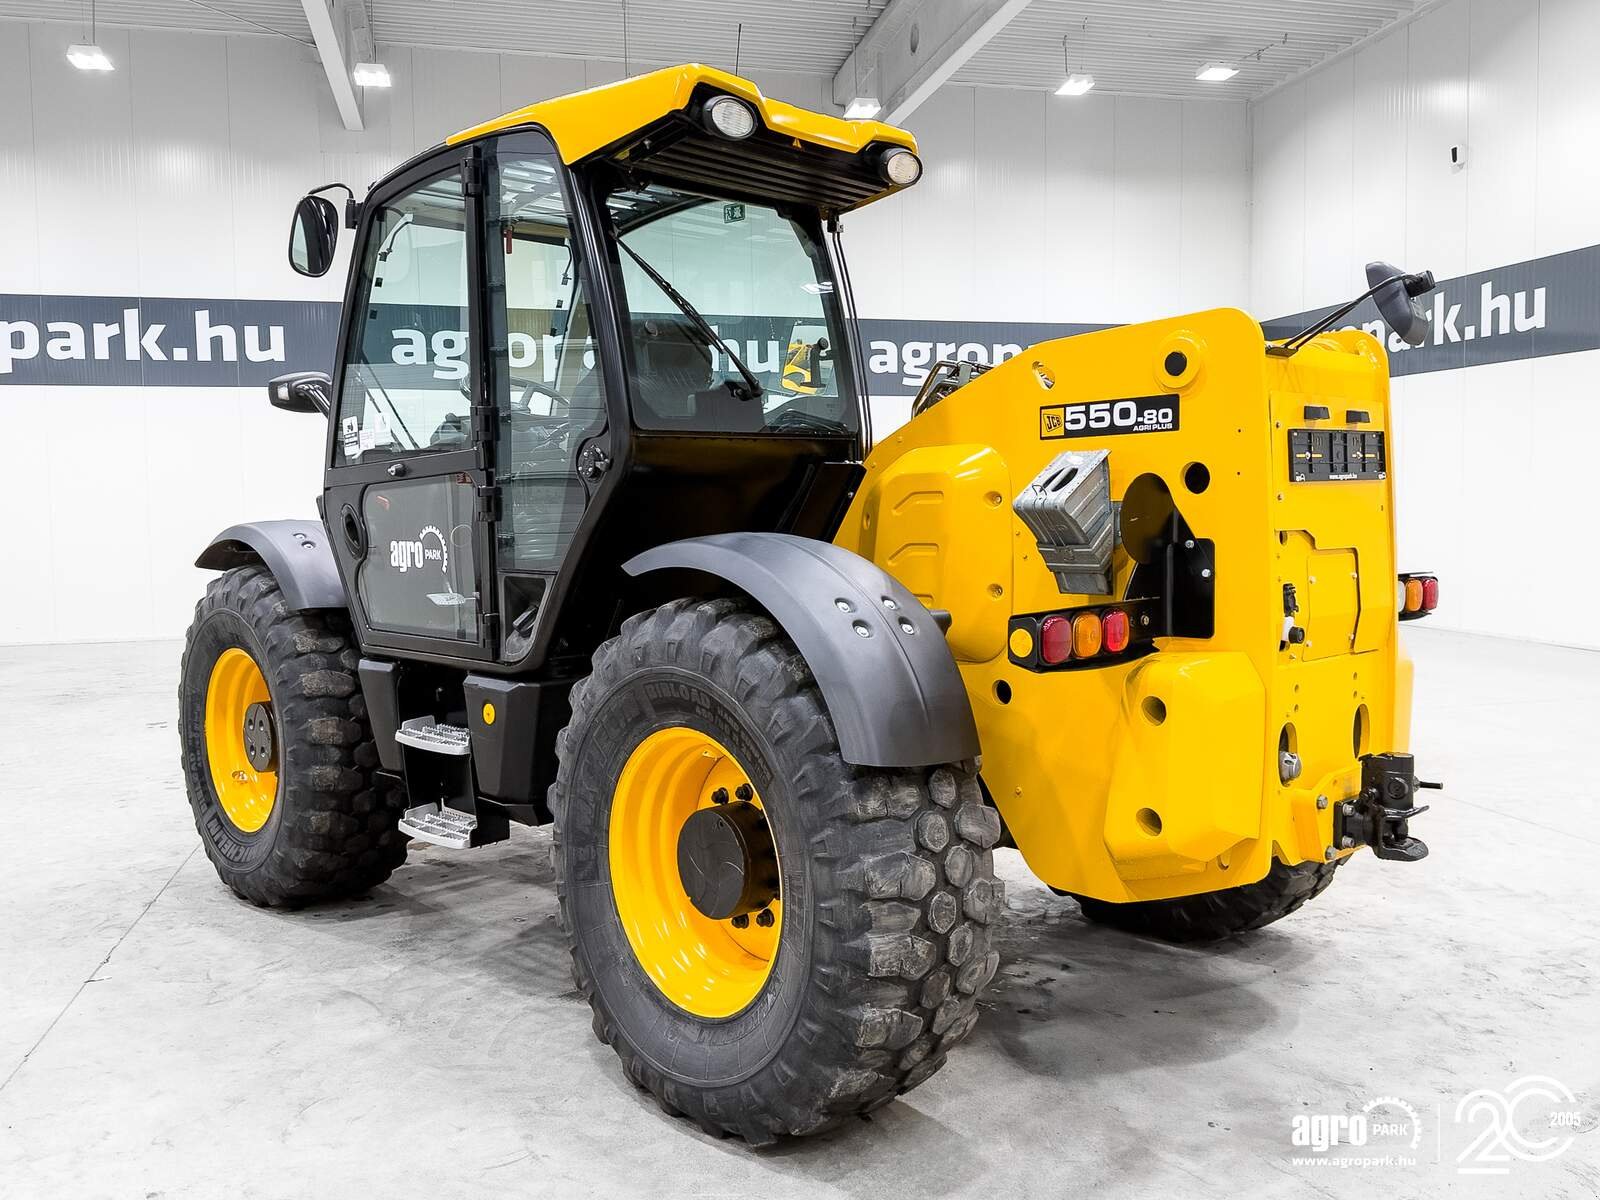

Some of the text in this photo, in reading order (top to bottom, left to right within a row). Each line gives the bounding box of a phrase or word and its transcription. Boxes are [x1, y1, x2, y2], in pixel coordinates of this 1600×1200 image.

[1044, 400, 1173, 431] JCB 550-80
[1132, 422, 1173, 432] AGRI PLUS
[390, 540, 442, 573] agro PARK
